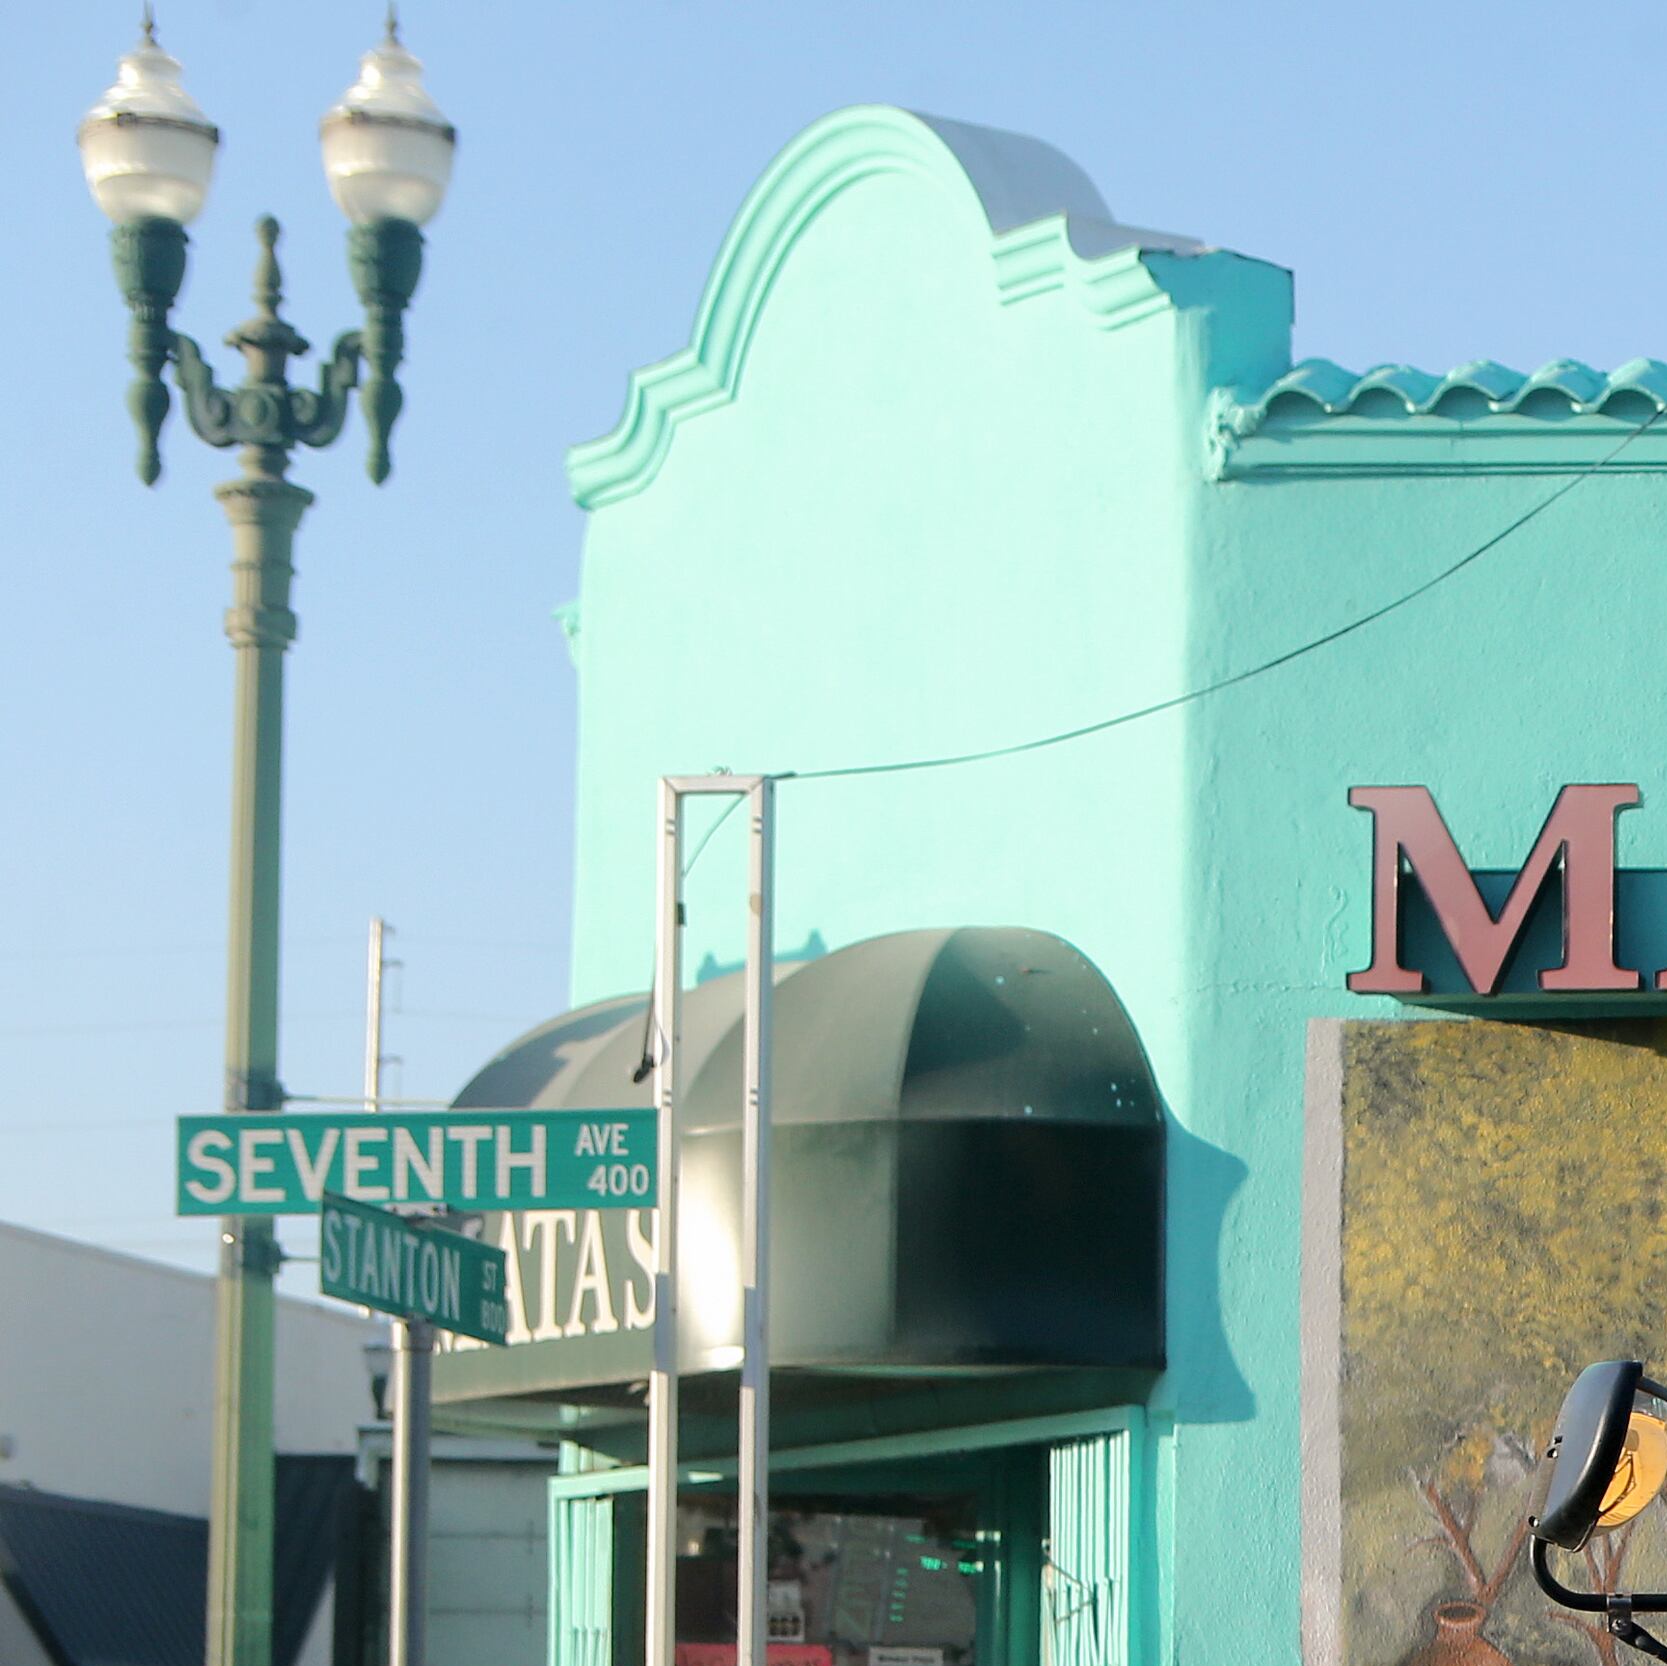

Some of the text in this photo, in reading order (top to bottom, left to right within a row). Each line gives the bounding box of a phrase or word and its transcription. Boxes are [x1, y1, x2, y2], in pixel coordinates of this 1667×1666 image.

[185, 1123, 629, 1203] SEVENTH AVE
[586, 1164, 649, 1196] 400
[323, 1208, 499, 1322] STANTON ST
[433, 1208, 659, 1356] ATAS
